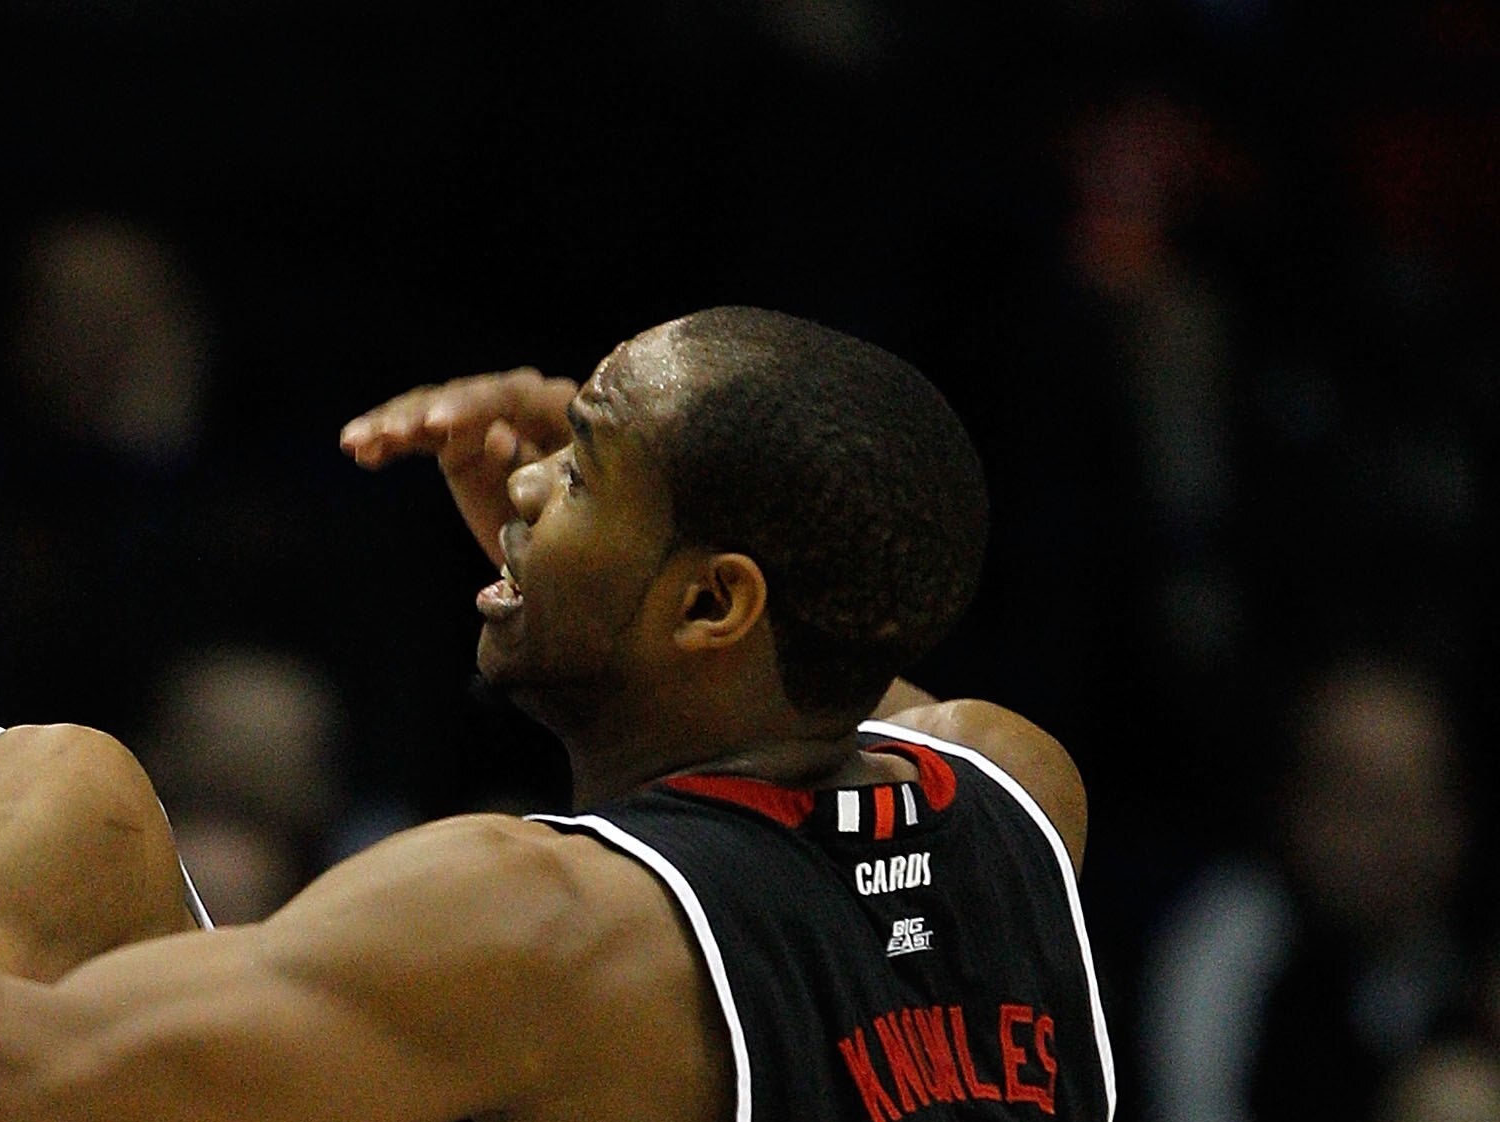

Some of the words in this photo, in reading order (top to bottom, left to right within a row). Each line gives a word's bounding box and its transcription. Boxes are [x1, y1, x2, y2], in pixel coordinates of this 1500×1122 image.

[855, 851, 932, 896] CARDS
[892, 917, 925, 938] BIG
[886, 930, 934, 952] EAST
